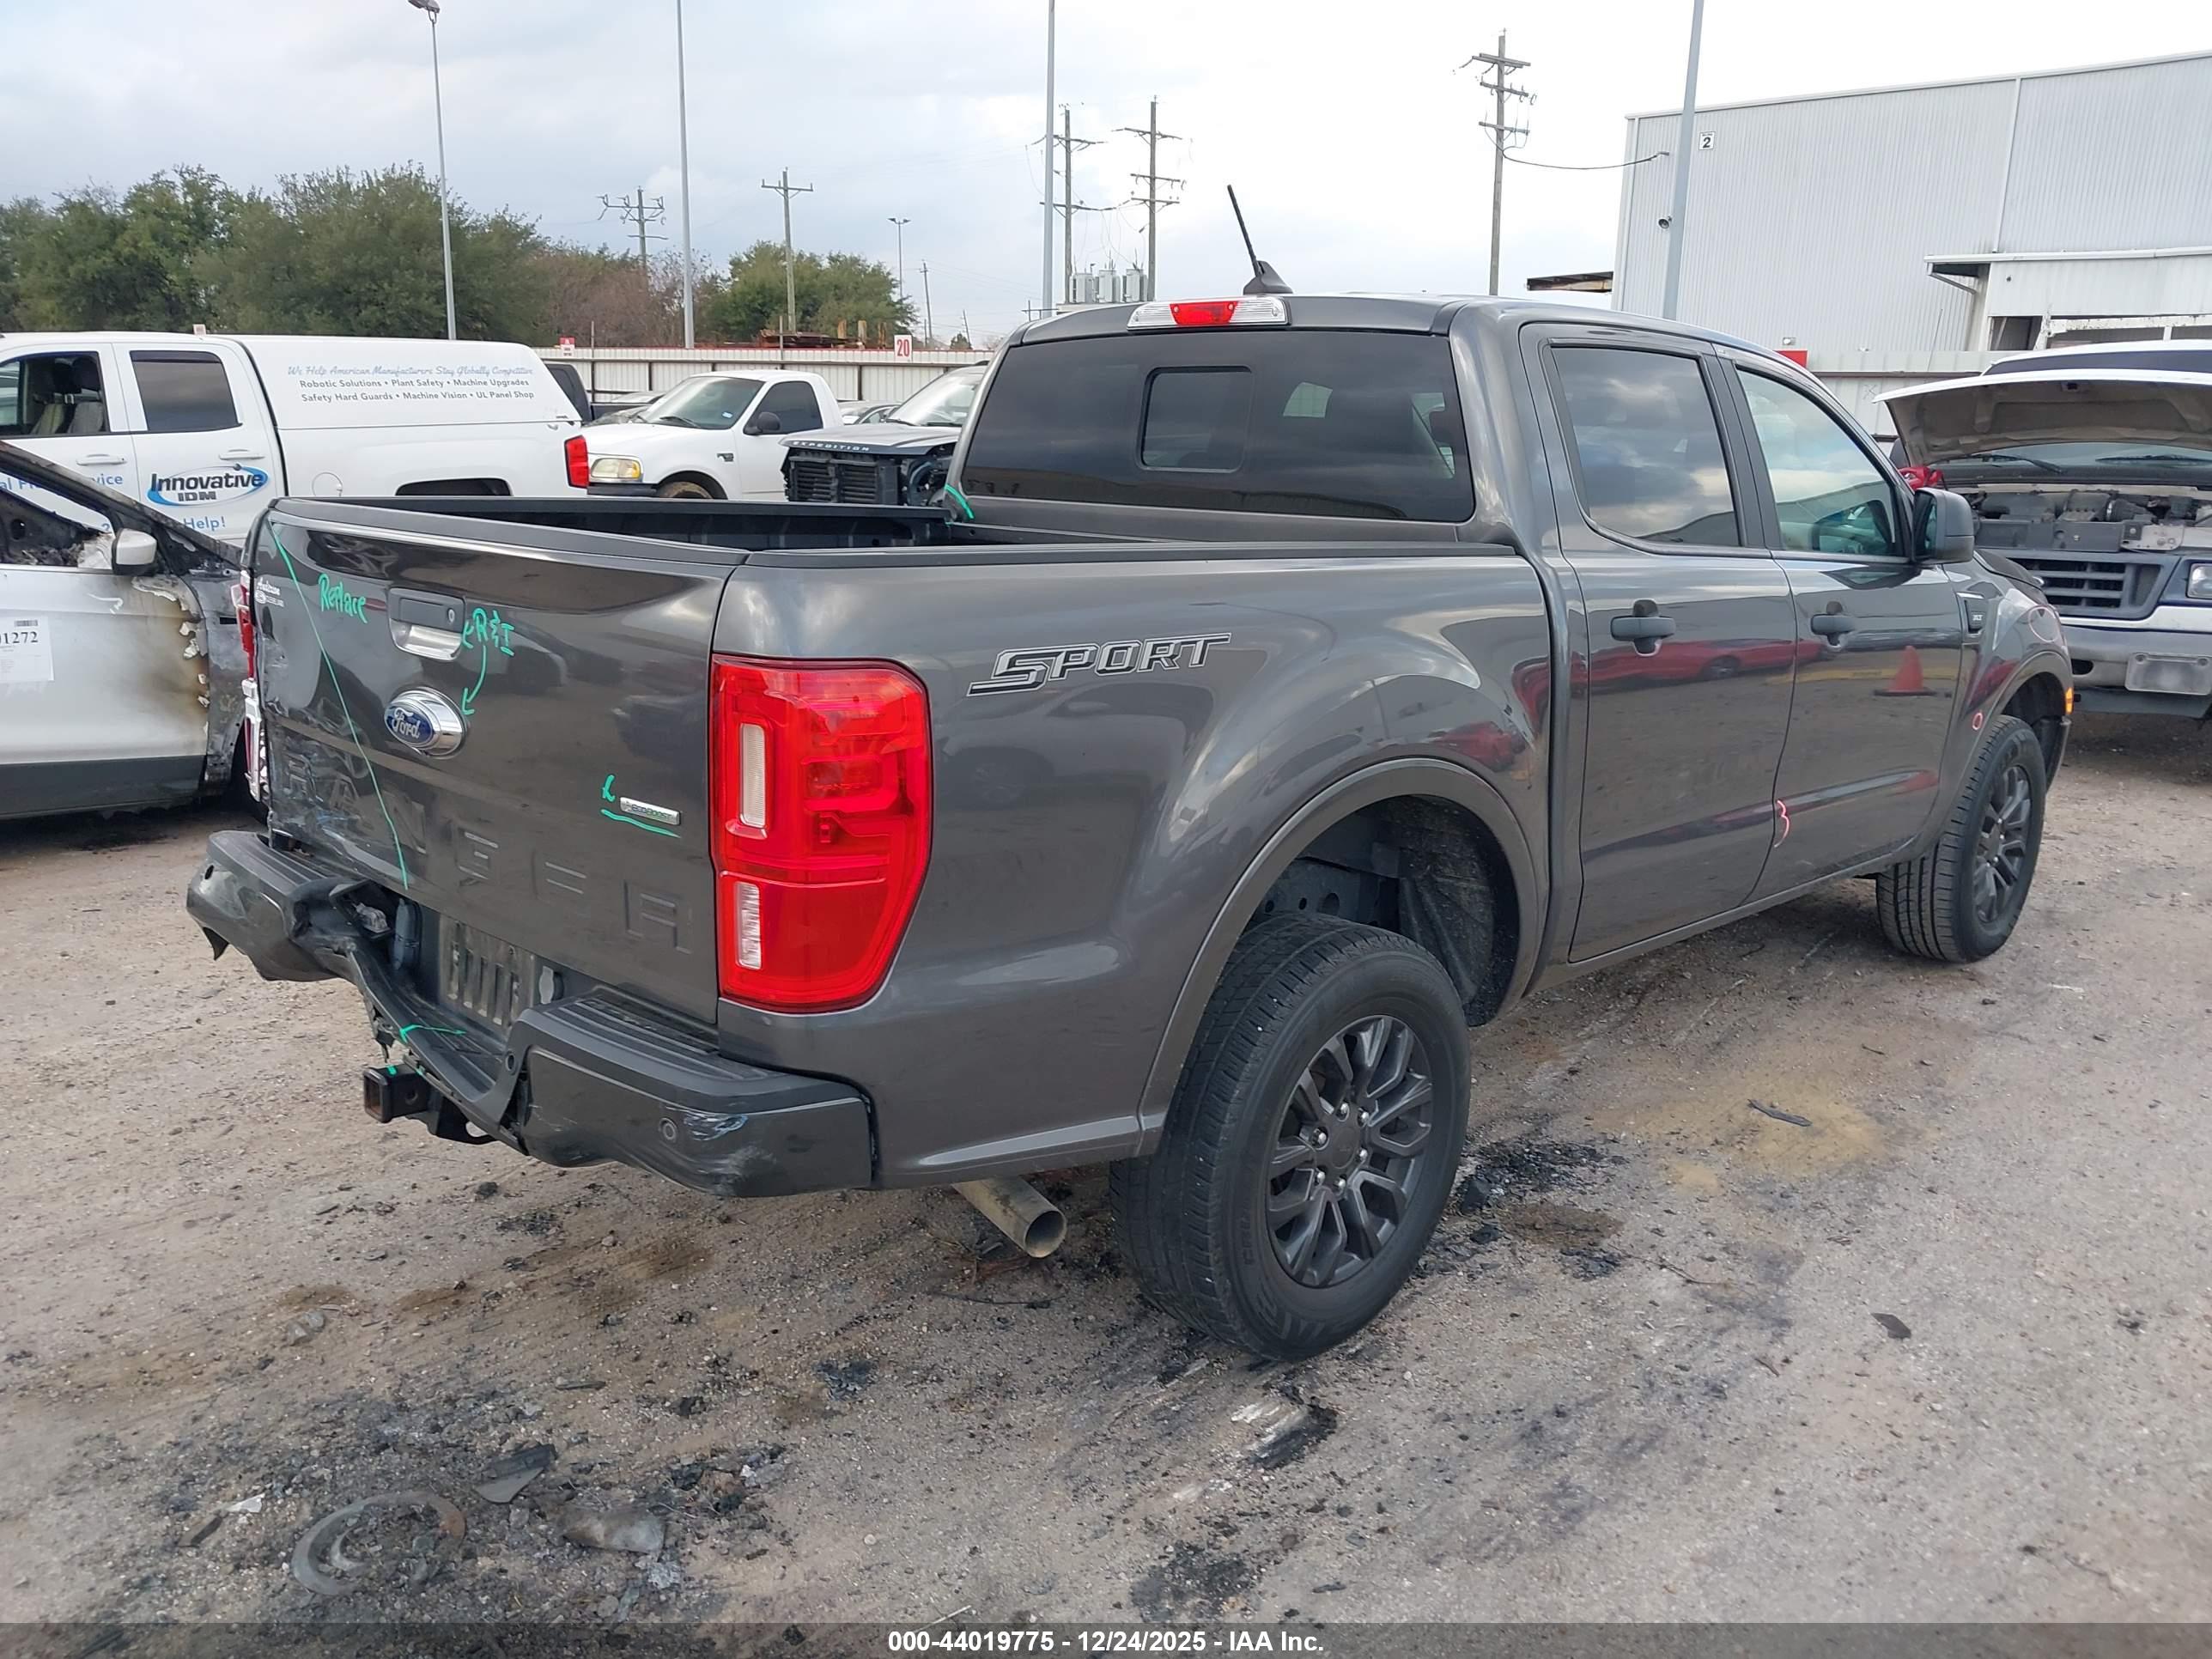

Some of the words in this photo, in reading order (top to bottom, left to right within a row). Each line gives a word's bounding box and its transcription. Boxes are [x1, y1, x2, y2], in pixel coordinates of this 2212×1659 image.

[1702, 137, 1711, 149] 2
[896, 338, 910, 357] 20
[288, 366, 302, 375] We
[306, 366, 326, 376] Help
[330, 366, 370, 375] American
[372, 365, 432, 377] Manufacturers
[435, 366, 454, 376] Stay
[457, 365, 490, 377] Globally
[299, 380, 337, 388] Robotic
[416, 379, 444, 388] Safety
[489, 379, 530, 387] Upgrades
[301, 393, 332, 403] Safety
[335, 392, 358, 401] Hard
[361, 392, 393, 400] Guards
[441, 391, 468, 399] Vision
[514, 391, 534, 399] Shop
[792, 441, 870, 452] EXPEDITION
[150, 471, 264, 492] Innovative
[178, 491, 217, 502] IDM
[0, 631, 39, 644] 1272
[966, 633, 1231, 696] SPORT
[391, 708, 423, 738] Ford
